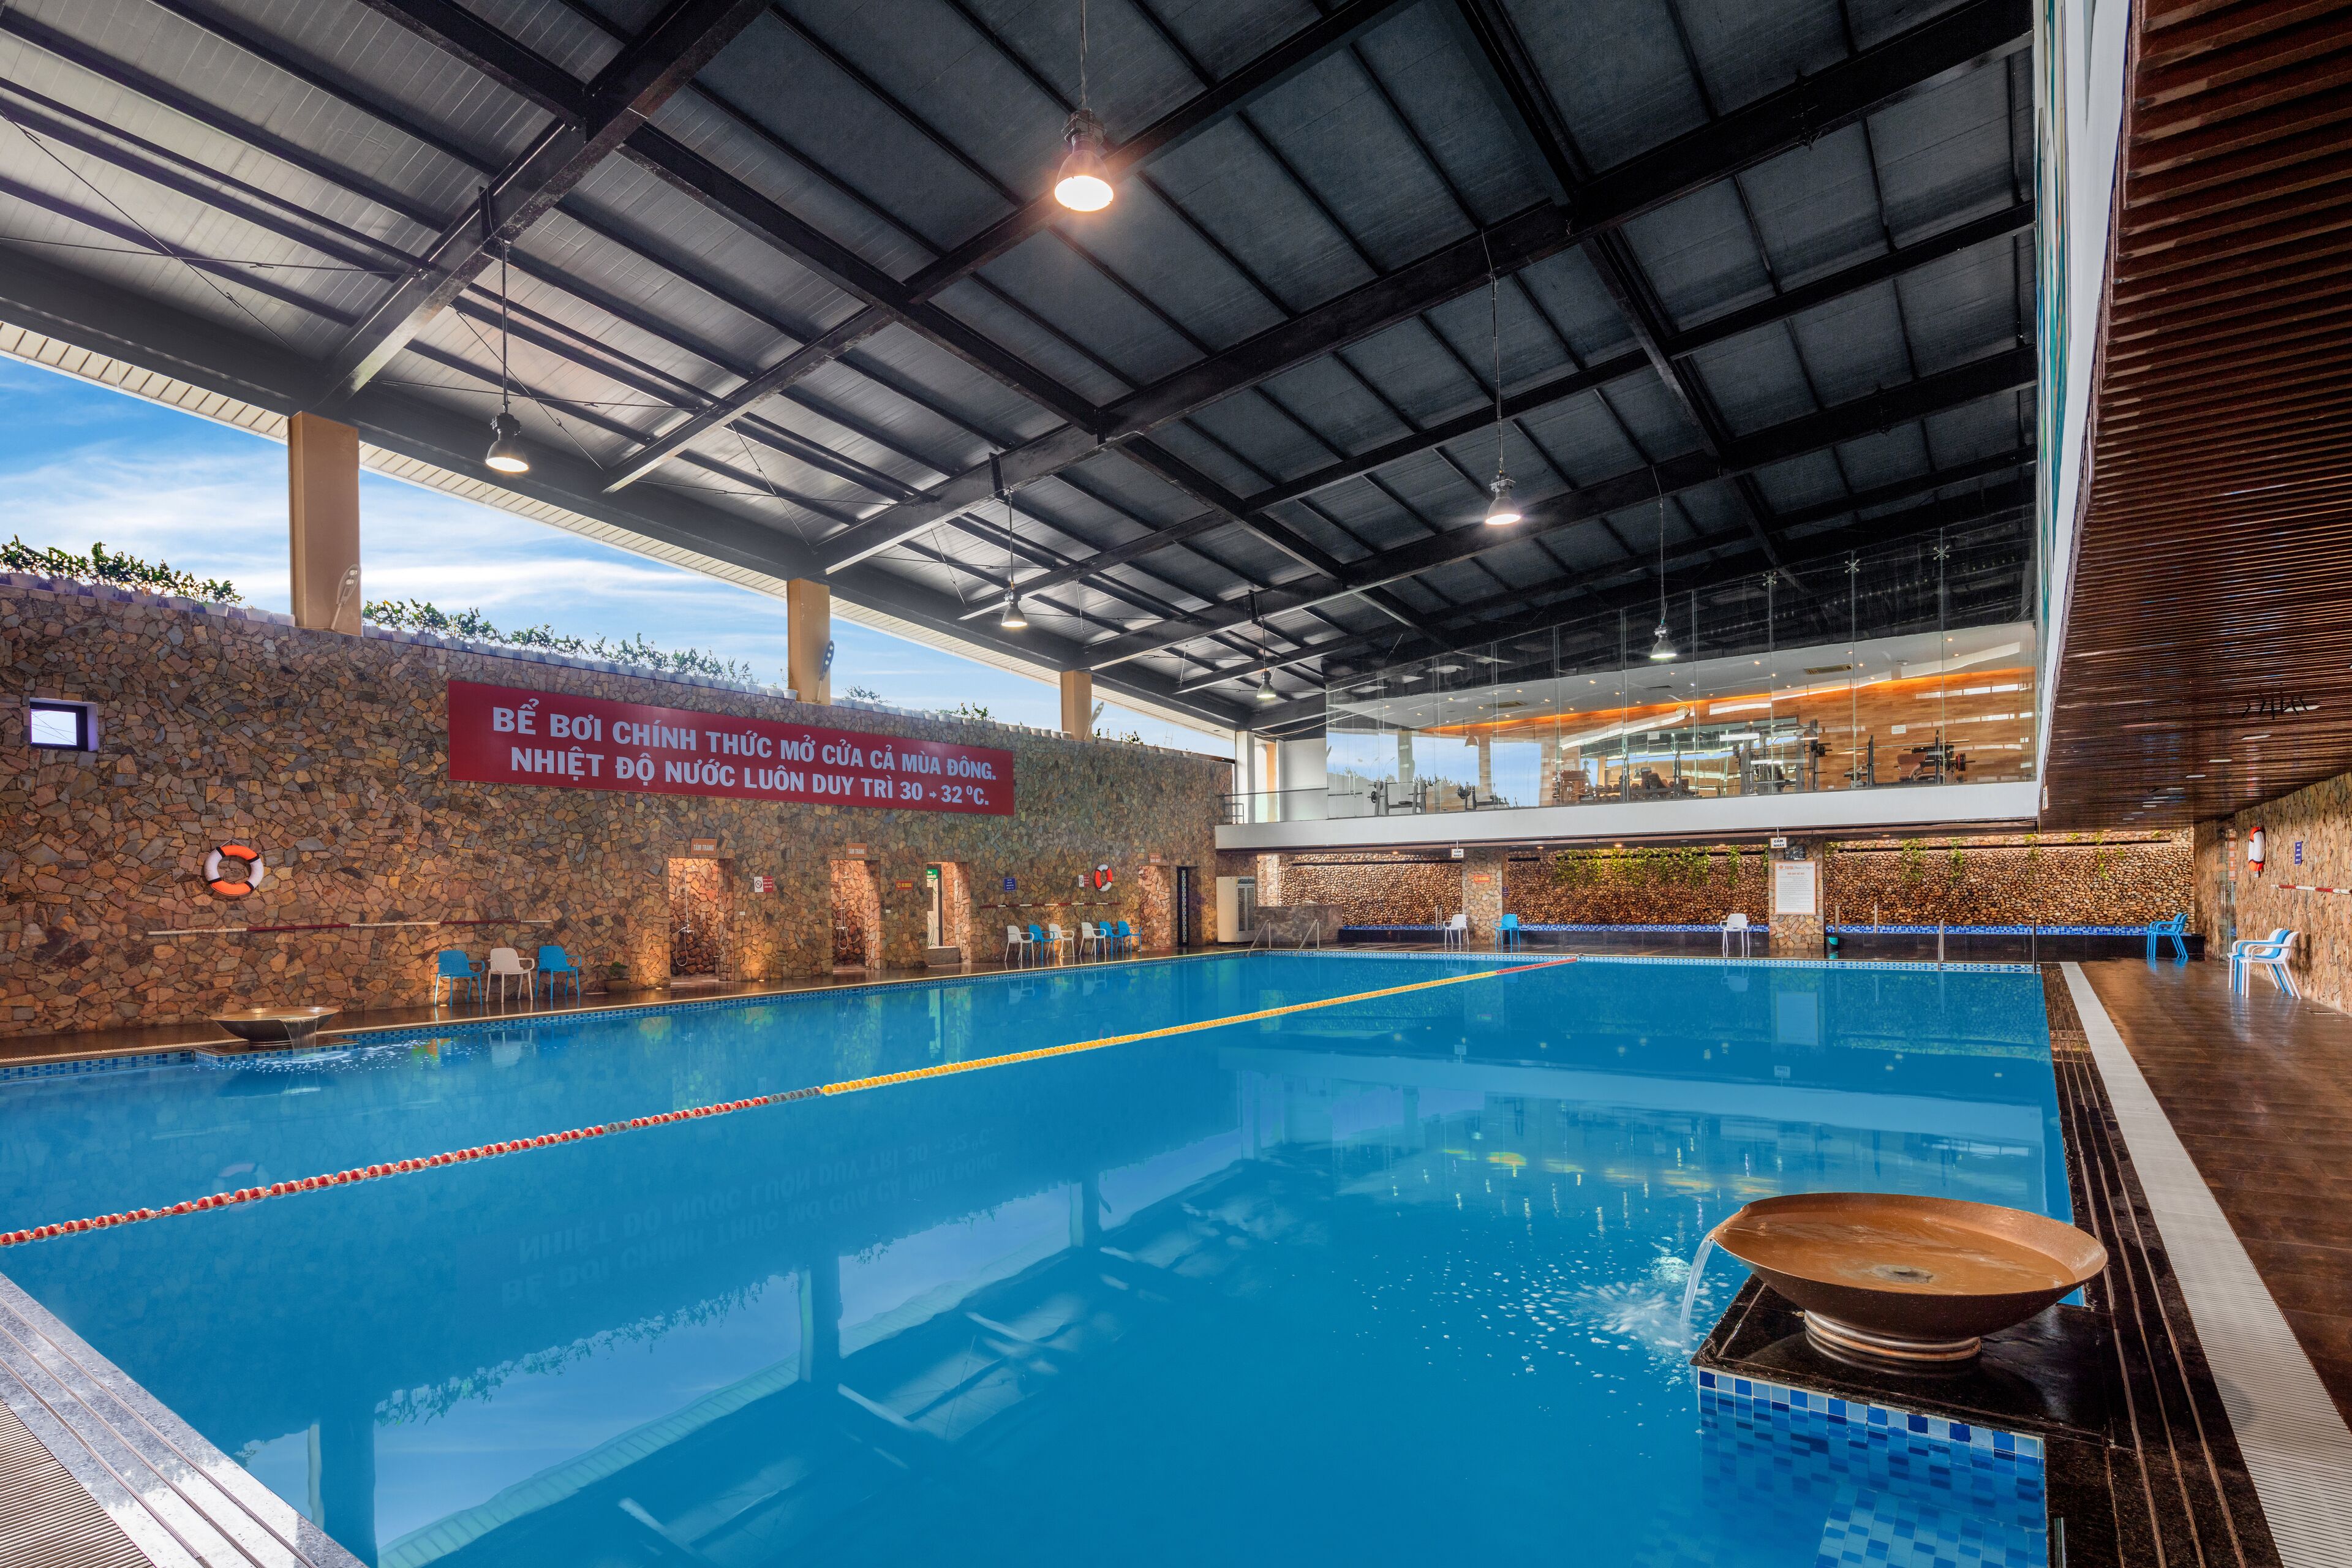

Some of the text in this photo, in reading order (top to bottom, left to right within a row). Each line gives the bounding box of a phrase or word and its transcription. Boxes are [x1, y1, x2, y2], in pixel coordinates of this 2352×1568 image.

[493, 698, 996, 780] BỂ BƠI CHÍNH THỨC MỞ CỬA CẢ MÙA ĐÔNG.
[511, 746, 605, 781] NHIỆT
[615, 752, 655, 786] ĐỘ
[665, 758, 736, 787] NƯỚC
[744, 764, 804, 792] LUÔN
[812, 774, 854, 795] DUY
[861, 775, 893, 798] TRÌ
[899, 781, 923, 801] 30
